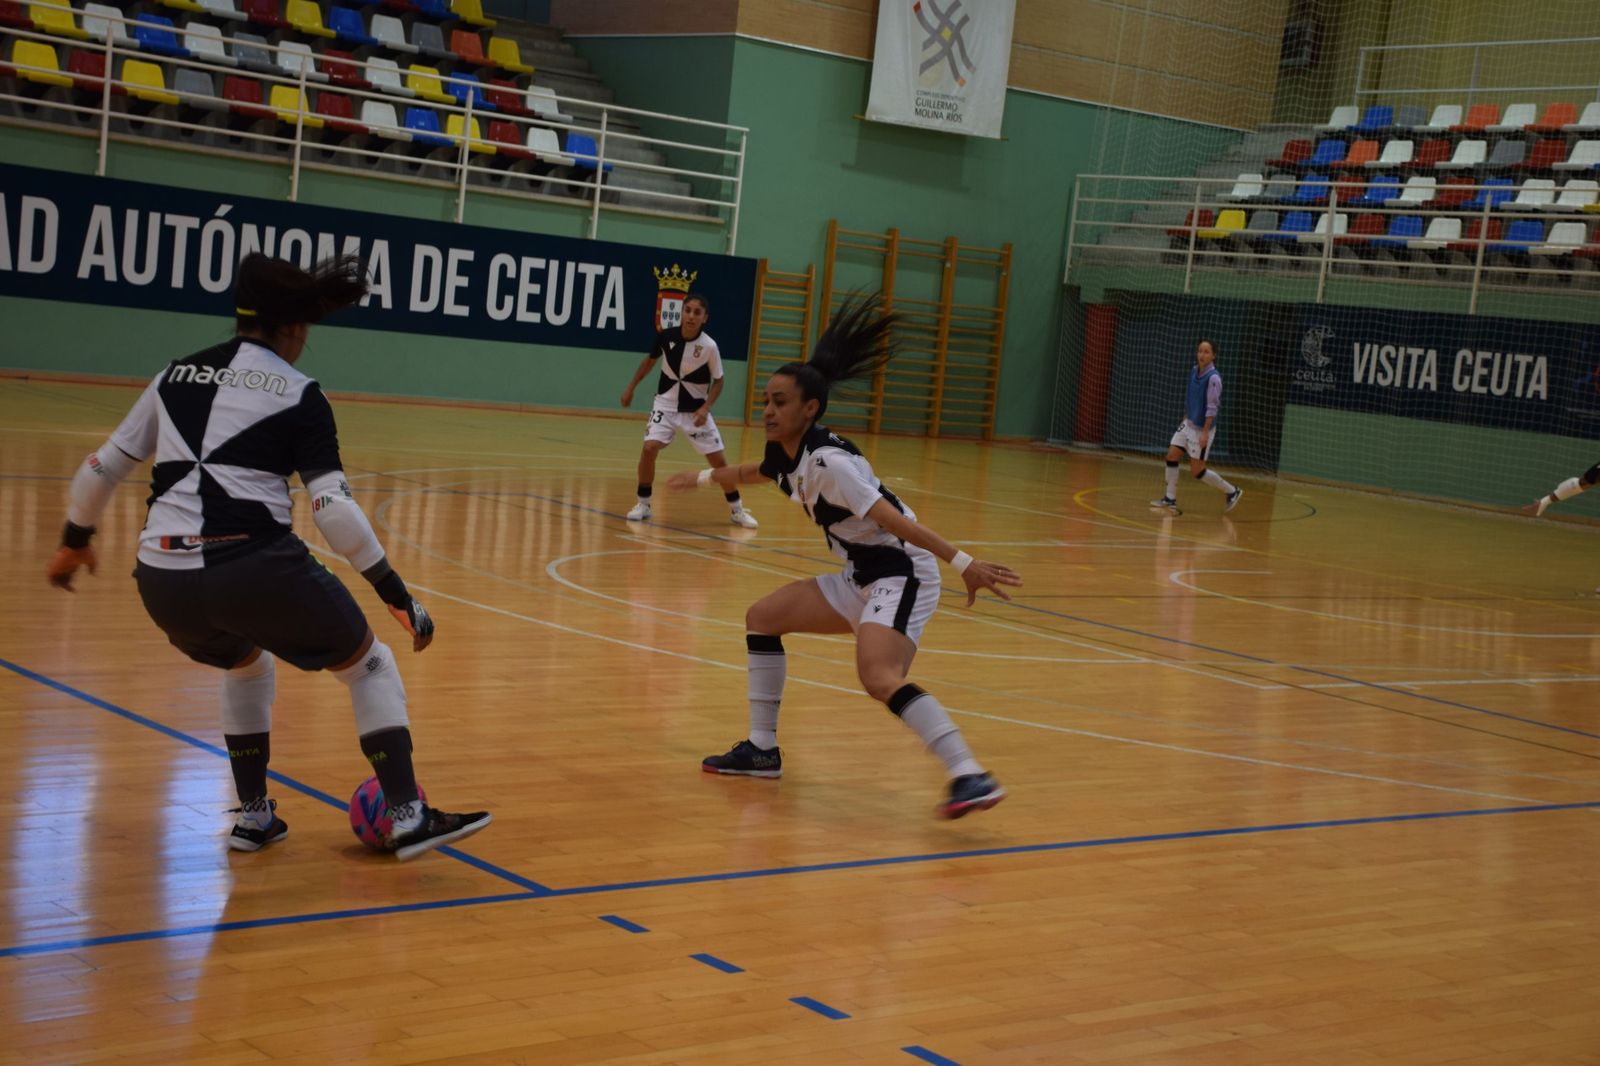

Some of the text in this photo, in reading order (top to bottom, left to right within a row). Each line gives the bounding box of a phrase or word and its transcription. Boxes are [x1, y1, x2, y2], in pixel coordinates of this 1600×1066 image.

[915, 97, 958, 112] GUILLERMO
[915, 108, 944, 120] MOLINA
[409, 243, 475, 317] DE
[486, 252, 626, 331] CEUTA
[168, 363, 287, 396] macron
[1353, 342, 1548, 400] VISITA CEUTA
